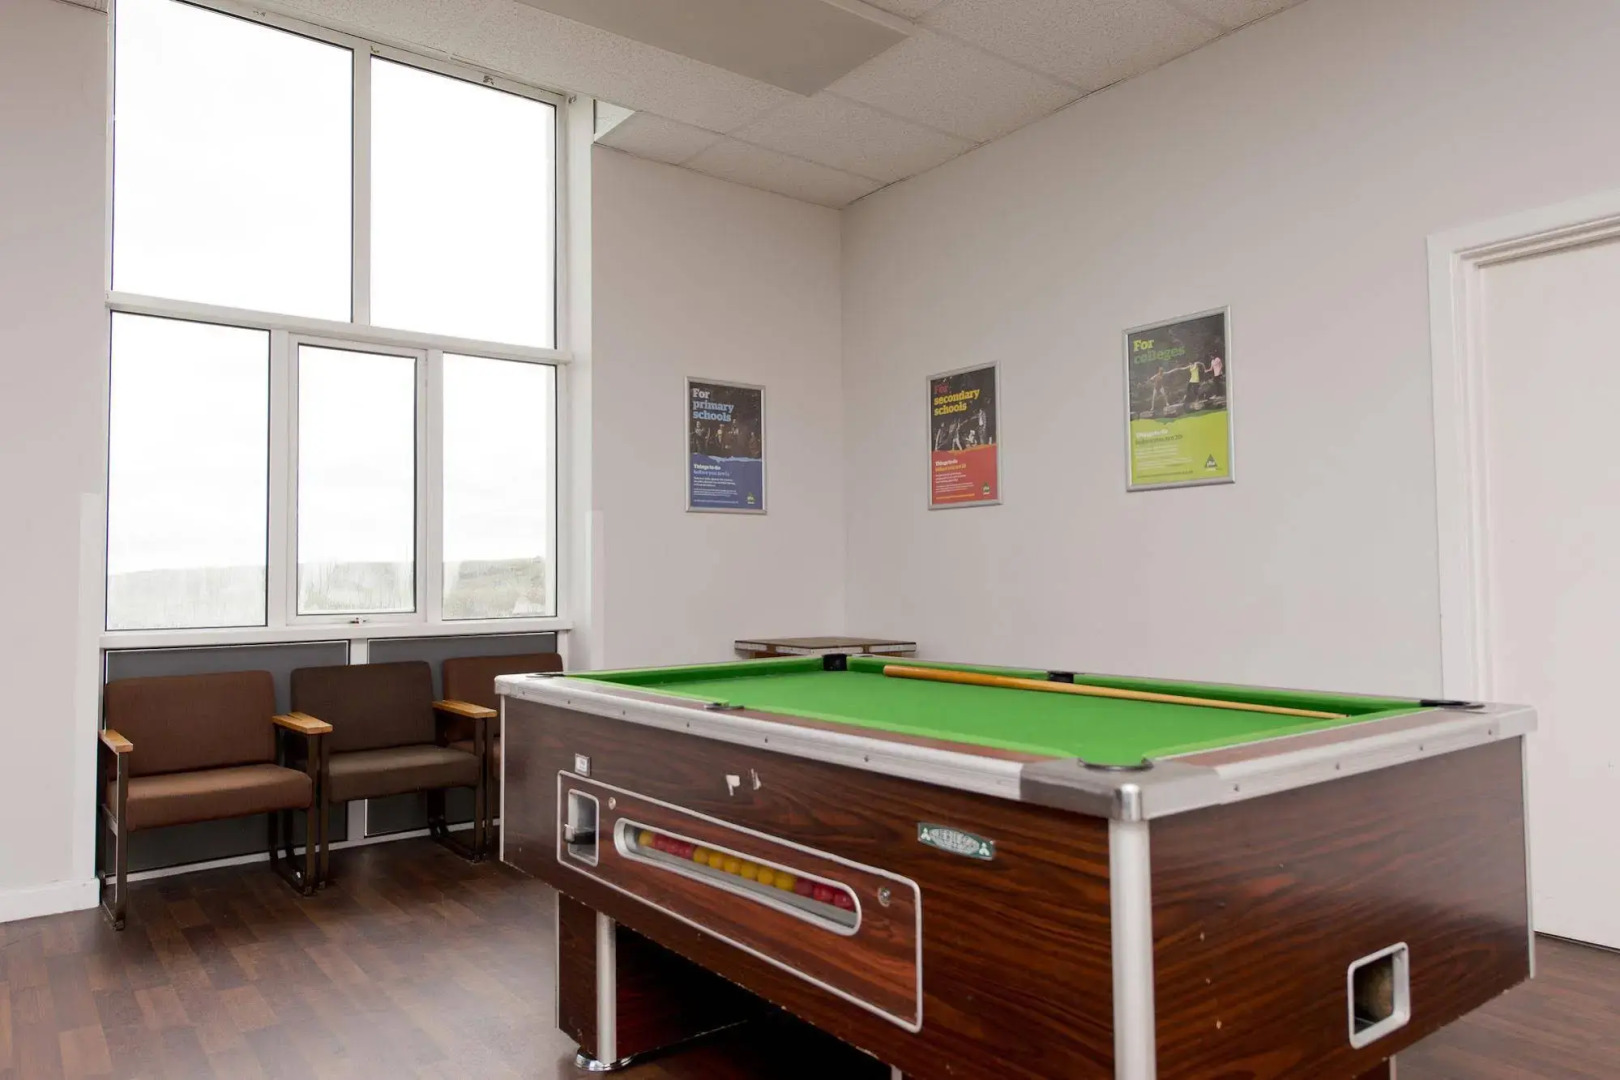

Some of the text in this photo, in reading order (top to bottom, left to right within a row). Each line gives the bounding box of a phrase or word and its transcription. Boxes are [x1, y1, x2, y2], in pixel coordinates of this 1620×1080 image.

[1133, 339, 1154, 352] For
[1134, 346, 1185, 364] colleges
[692, 388, 710, 399] For
[934, 389, 980, 405] secondary
[692, 400, 735, 414] primary
[934, 402, 967, 416] schools
[692, 410, 731, 422] schools
